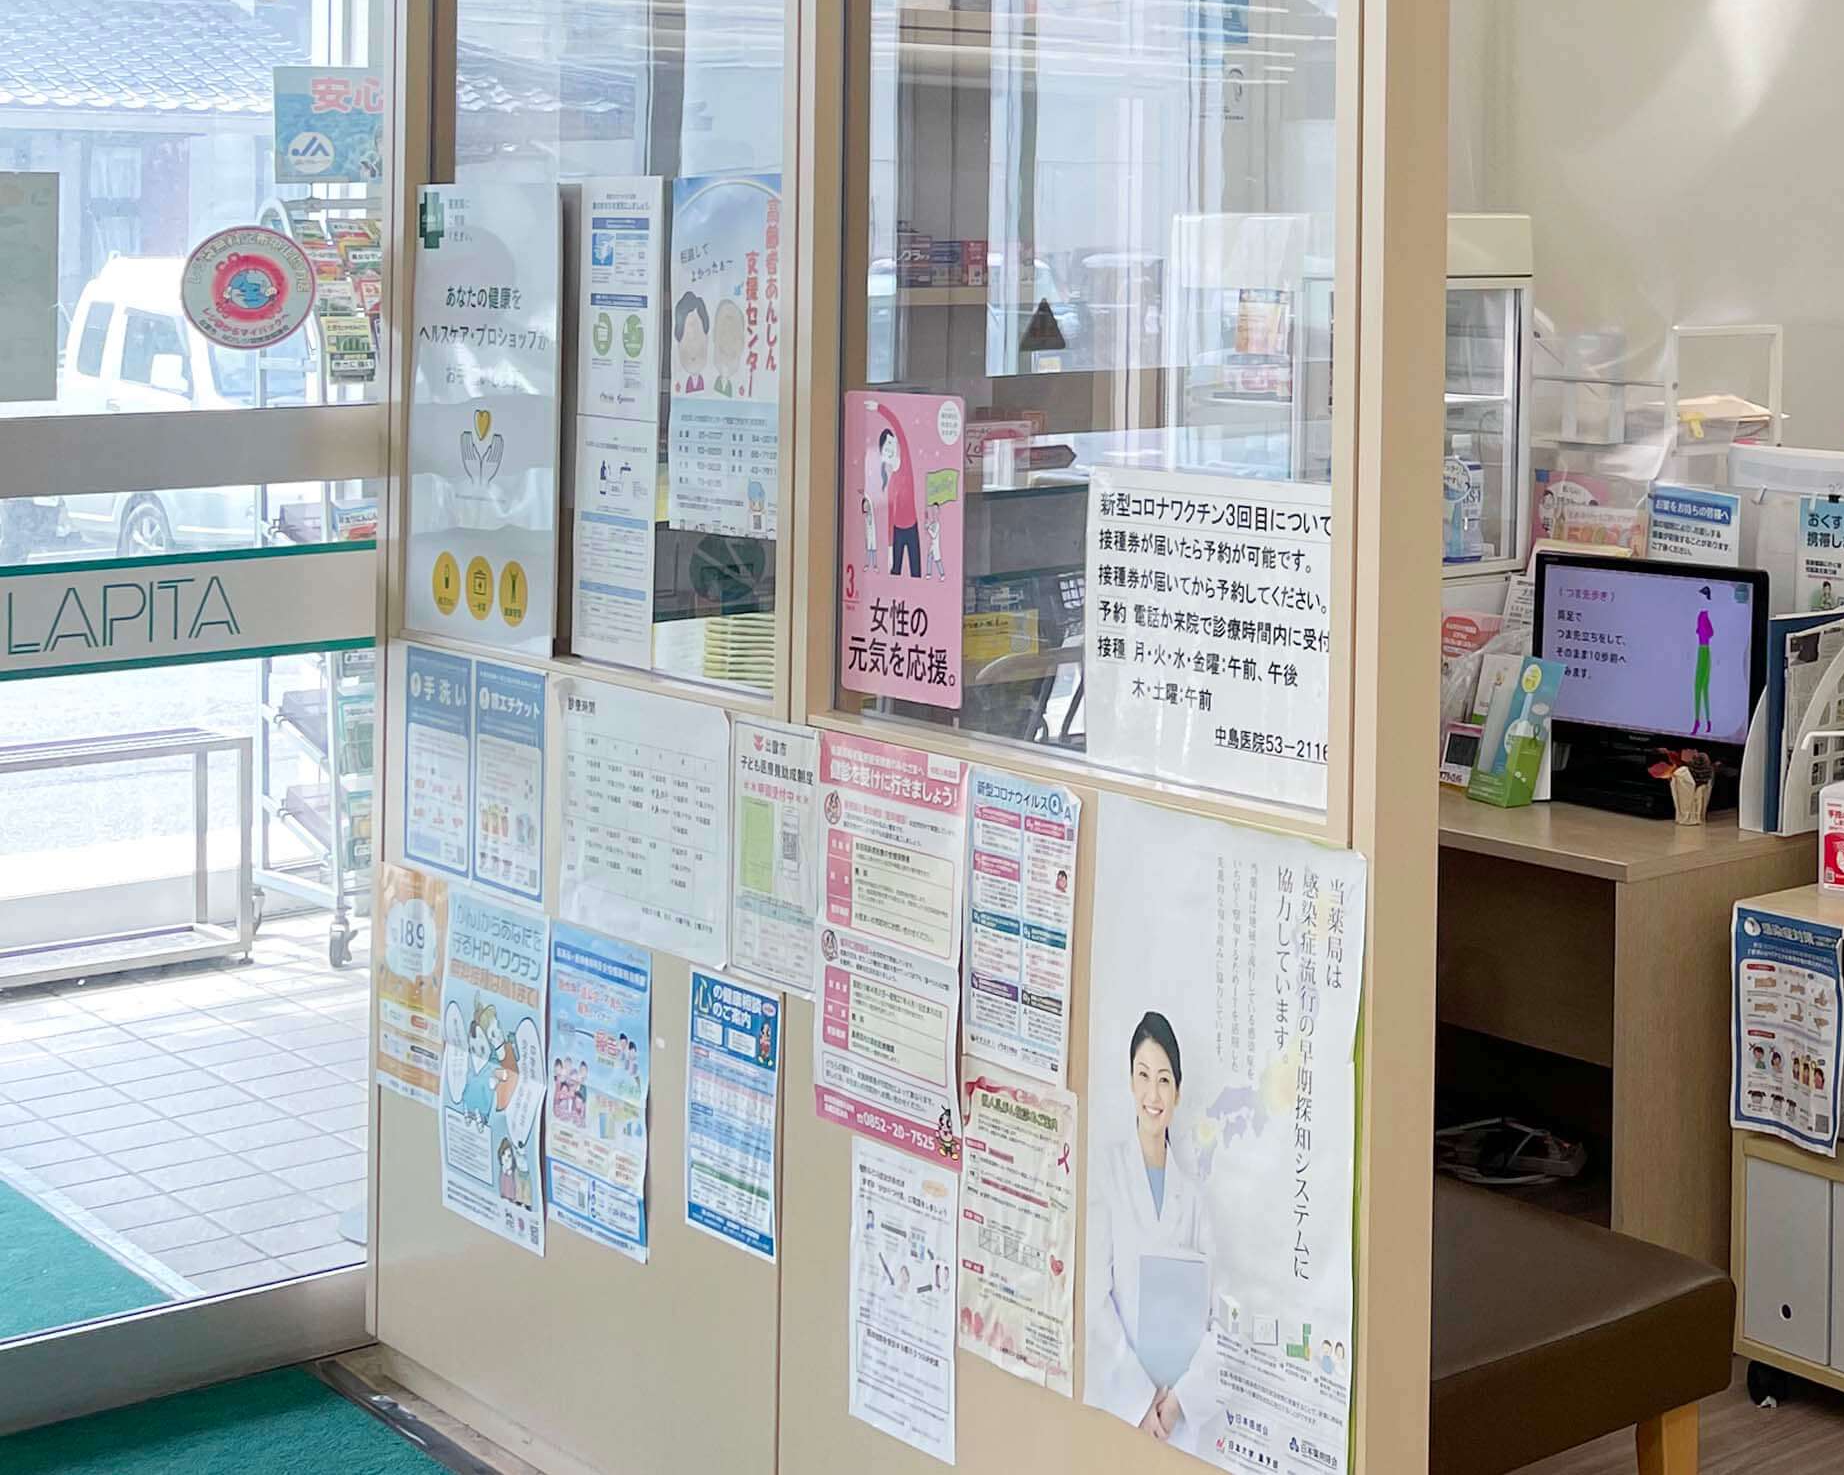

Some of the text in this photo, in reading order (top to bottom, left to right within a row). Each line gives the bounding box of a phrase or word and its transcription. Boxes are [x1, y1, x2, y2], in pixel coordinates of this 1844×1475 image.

[445, 285, 522, 311] あなたの健康を
[1100, 492, 1332, 537] 新型コロナワクチン3回目について
[1098, 528, 1312, 574] 接種券が届いたら予約が可能です。
[1098, 563, 1328, 615] 接種券が届いてから予約してください。
[7, 575, 241, 656] LAPITA
[869, 596, 929, 638] 女性の
[1098, 600, 1127, 625] 予約
[847, 635, 956, 688] 元気を応援。
[1097, 635, 1126, 661] 接種
[1555, 646, 1628, 664] そのまま10歩前へ
[977, 780, 1048, 811] 新型コロナウイルス
[400, 917, 425, 950] 189
[1325, 877, 1345, 990] 当薬局は
[1273, 864, 1294, 1065] 協力しています。
[1293, 870, 1320, 1281] 感染症流行の早期探知システムに
[863, 1111, 936, 1151] 0852-20-7525
